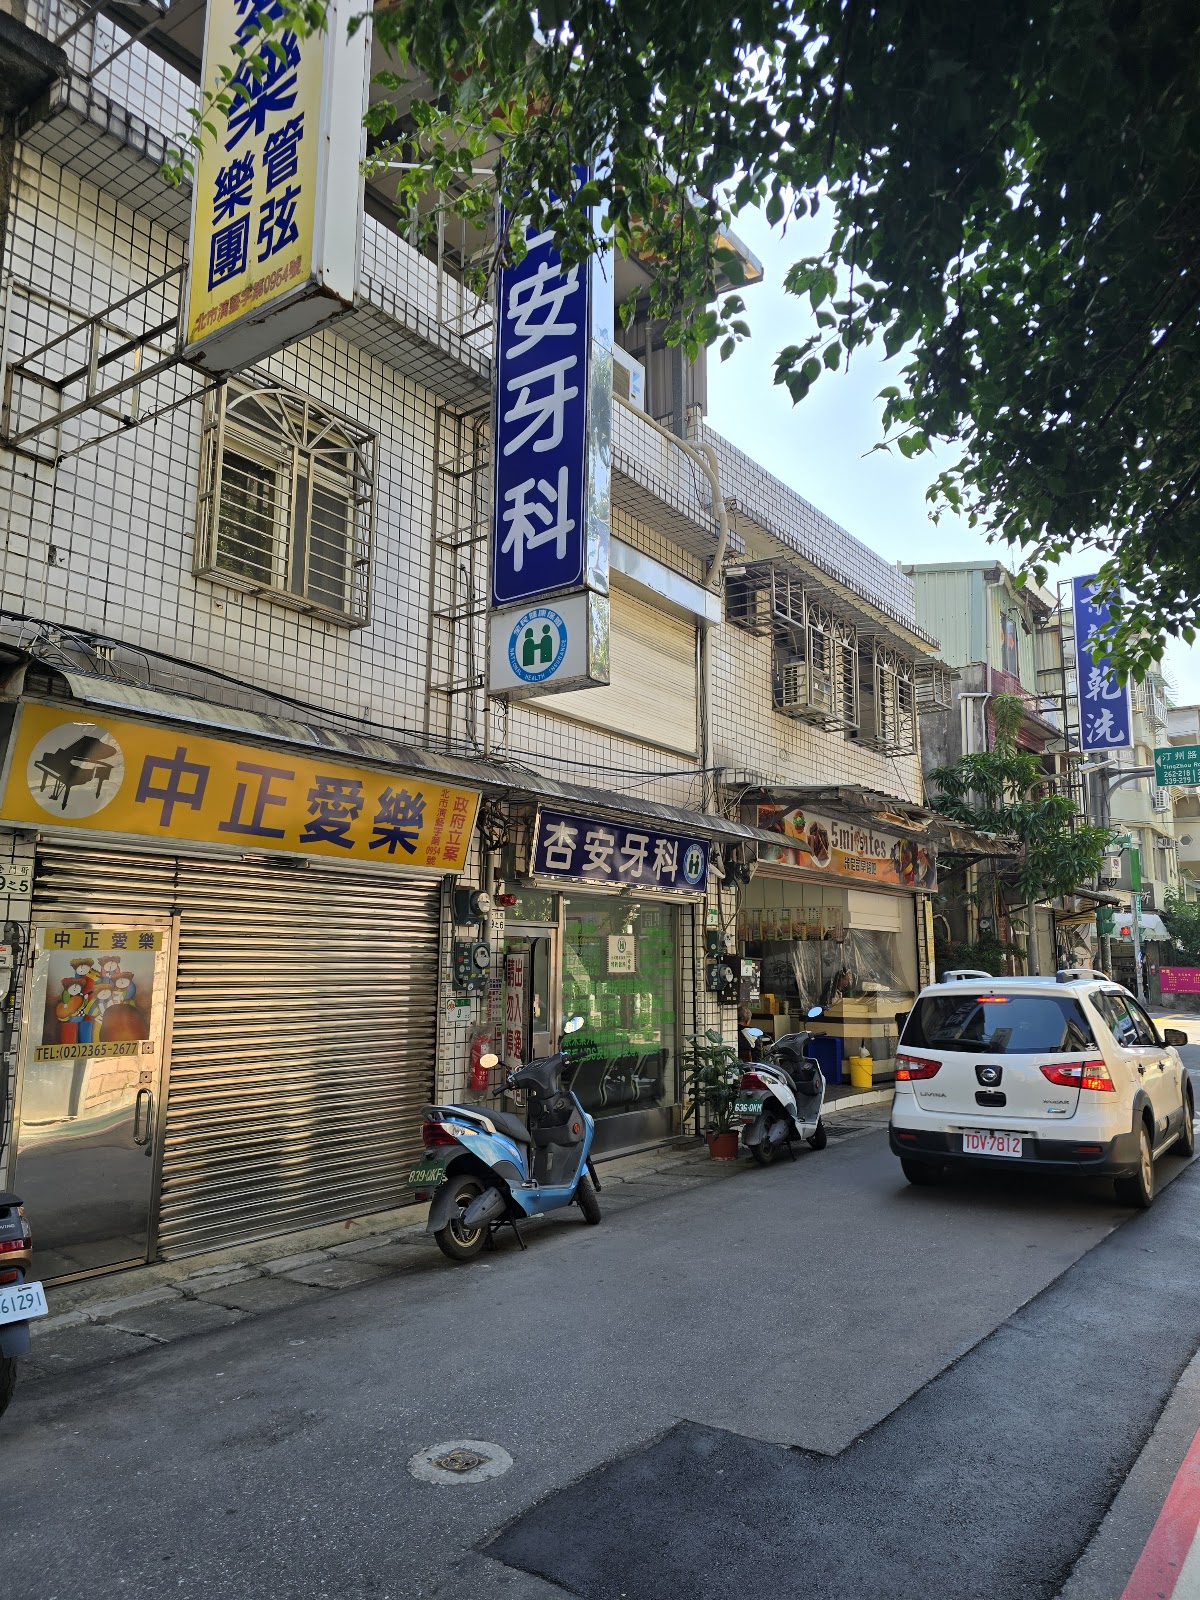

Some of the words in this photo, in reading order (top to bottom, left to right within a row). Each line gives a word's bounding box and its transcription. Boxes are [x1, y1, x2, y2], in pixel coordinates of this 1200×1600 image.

[257, 111, 305, 263] 管弦
[207, 150, 255, 293] 樂團
[525, 673, 545, 681] HEALTH
[135, 746, 427, 855] 中正愛樂
[443, 797, 469, 861] 政府立案
[543, 821, 679, 883] 杏安牙科
[54, 930, 155, 949] 中正愛樂
[36, 1042, 138, 1060] TEL:(02)2365-2677
